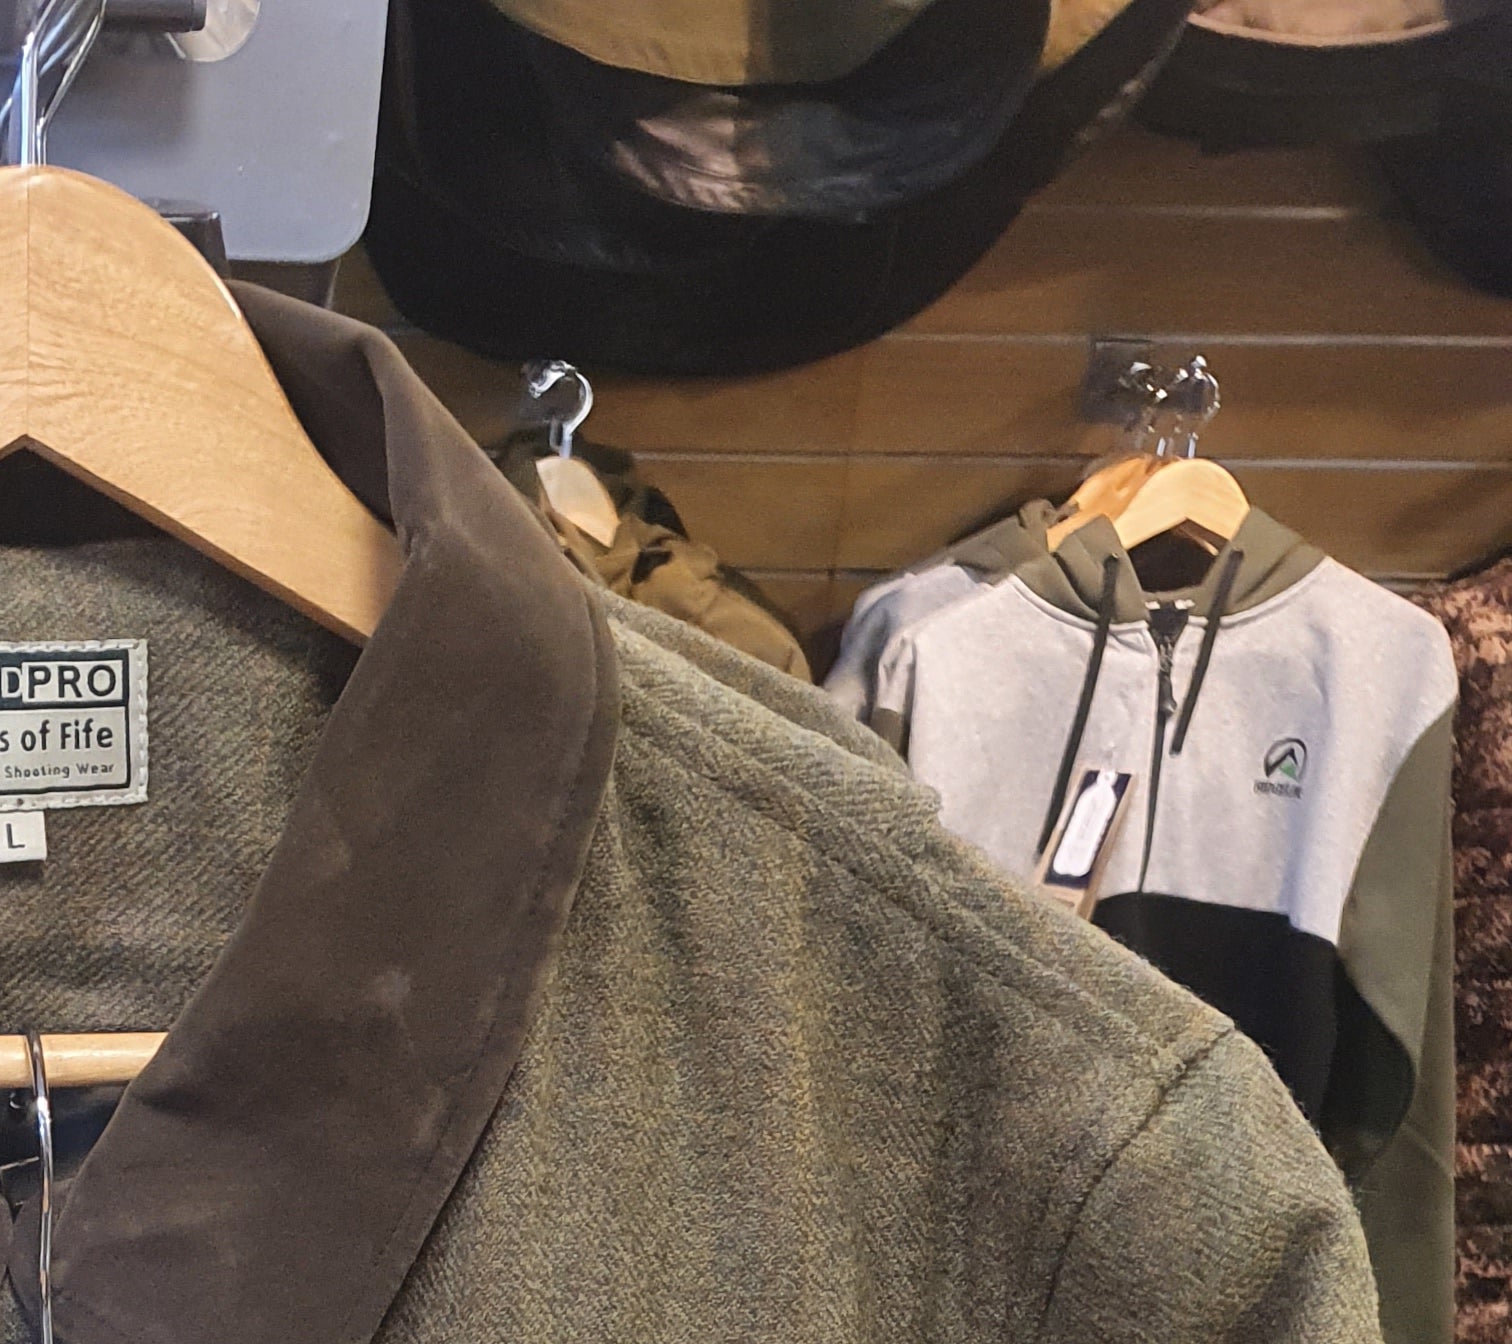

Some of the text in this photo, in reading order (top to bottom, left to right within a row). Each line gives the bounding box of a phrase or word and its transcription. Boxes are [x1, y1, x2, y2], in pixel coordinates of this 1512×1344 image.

[21, 719, 50, 751] of
[60, 718, 113, 750] Fife
[4, 766, 70, 779] Shooting
[76, 763, 115, 776] Wear
[6, 823, 26, 849] L
